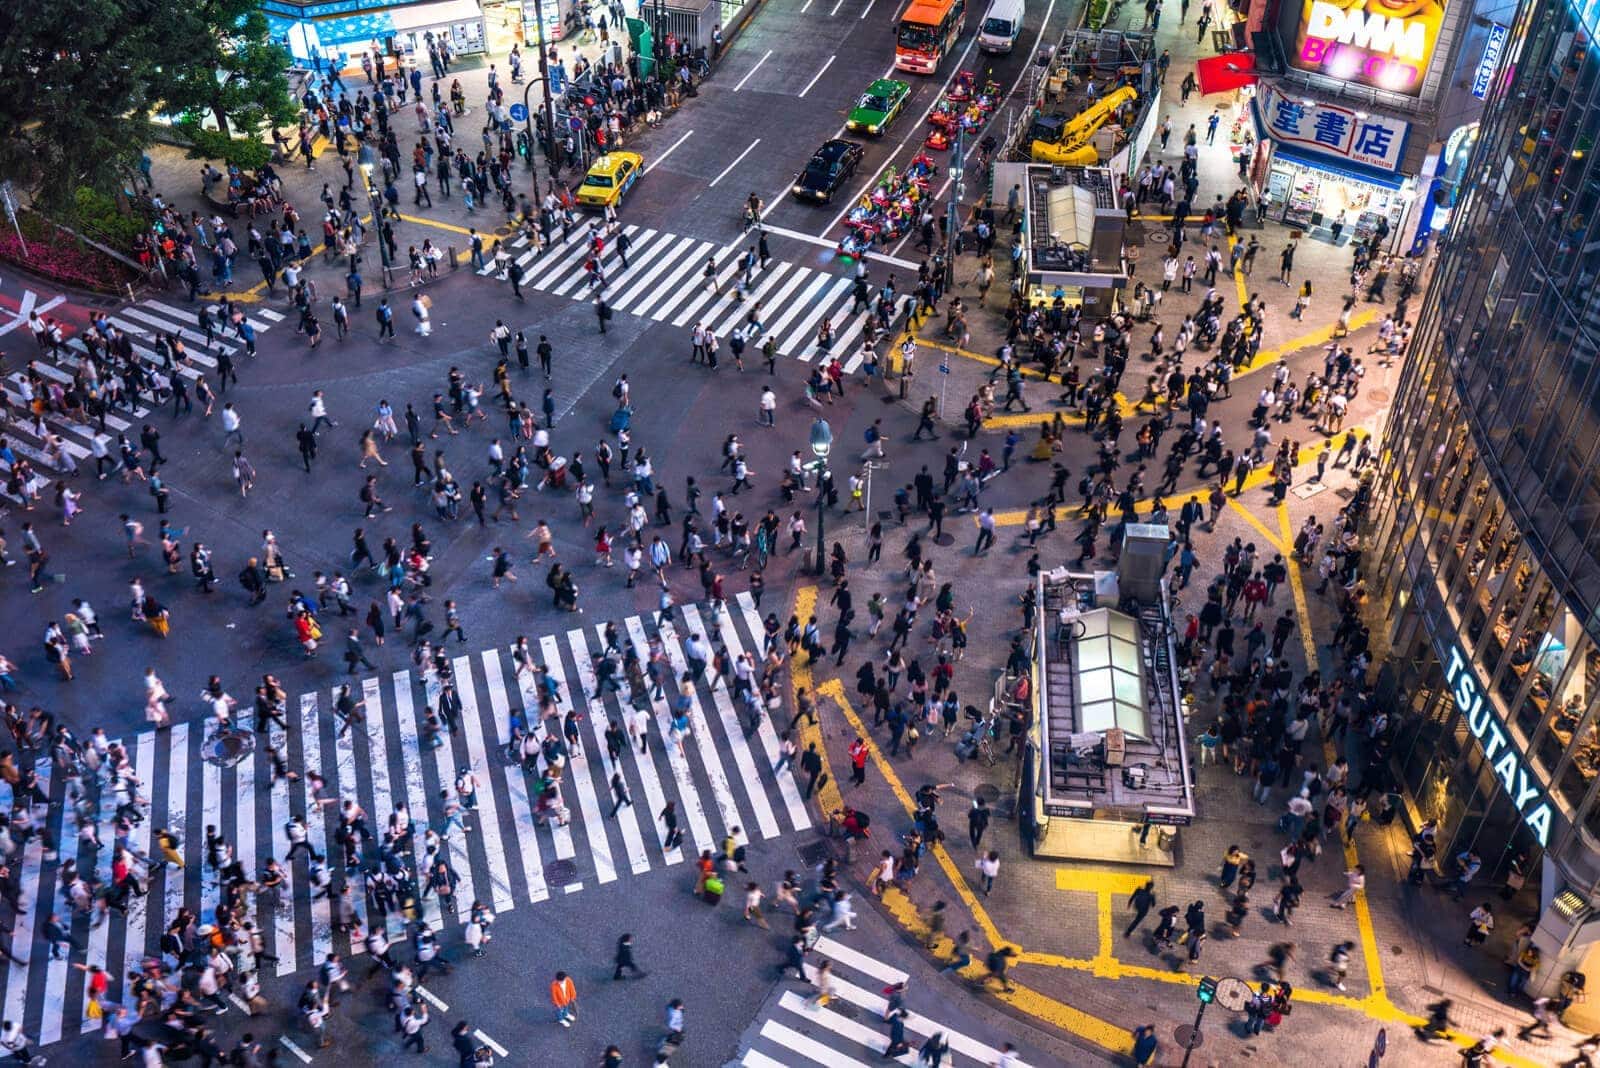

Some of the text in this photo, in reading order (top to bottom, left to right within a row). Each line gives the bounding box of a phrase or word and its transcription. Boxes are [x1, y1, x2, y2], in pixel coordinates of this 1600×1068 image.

[1301, 37, 1418, 86] Bioin
[1307, 0, 1425, 60] DMM
[1265, 88, 1394, 158] 堂書店
[1446, 646, 1553, 847] TSUTAYA
